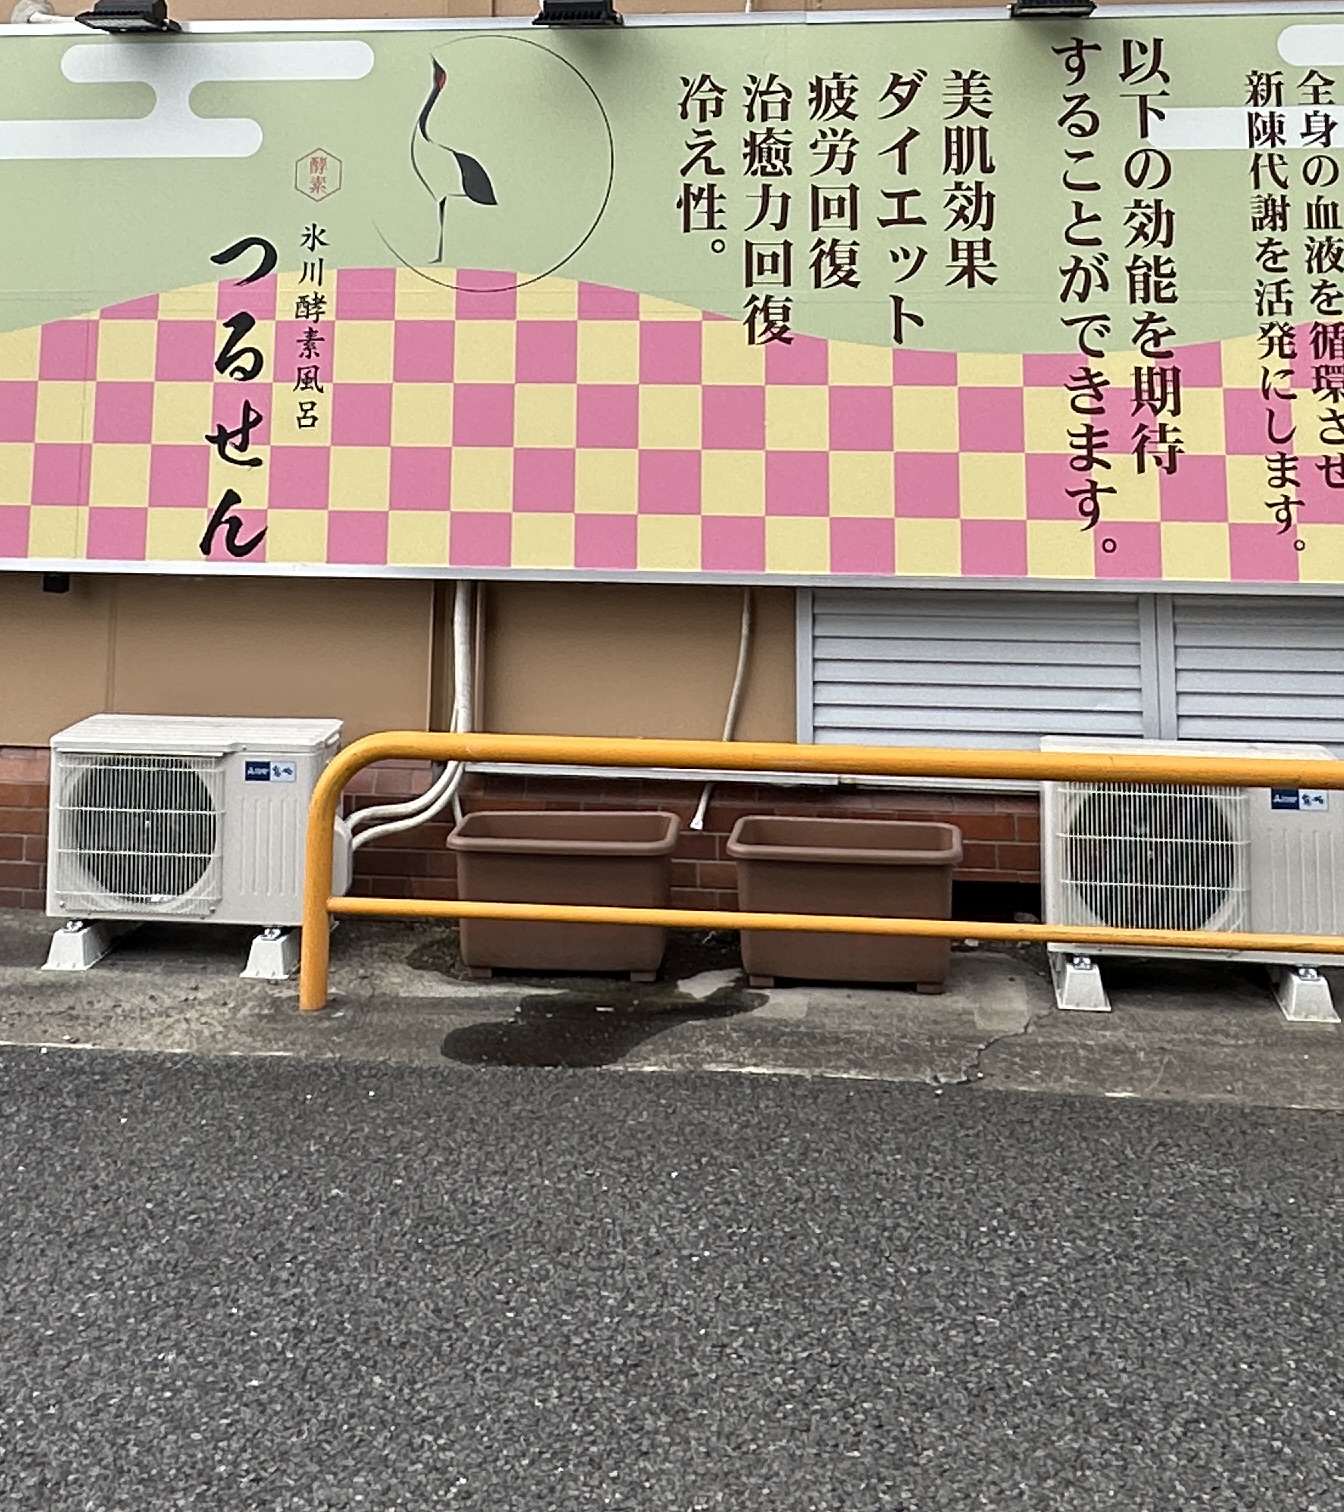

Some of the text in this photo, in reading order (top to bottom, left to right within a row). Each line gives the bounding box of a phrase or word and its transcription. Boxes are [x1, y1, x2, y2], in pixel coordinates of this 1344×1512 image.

[309, 155, 329, 195] 酵素
[676, 73, 727, 254] 冷え性。
[742, 72, 795, 346] 治癒力回復
[808, 71, 862, 290] 疲労回復
[876, 69, 929, 345] ダイエット
[942, 69, 998, 289] 美肌効果
[1051, 36, 1117, 555] することができます。
[1119, 37, 1185, 475] 以下の効能を期待
[198, 235, 278, 558] つるせん
[292, 222, 330, 430] 氷川酵素風呂
[1244, 70, 1306, 551] 新陳代謝を活発にします。
